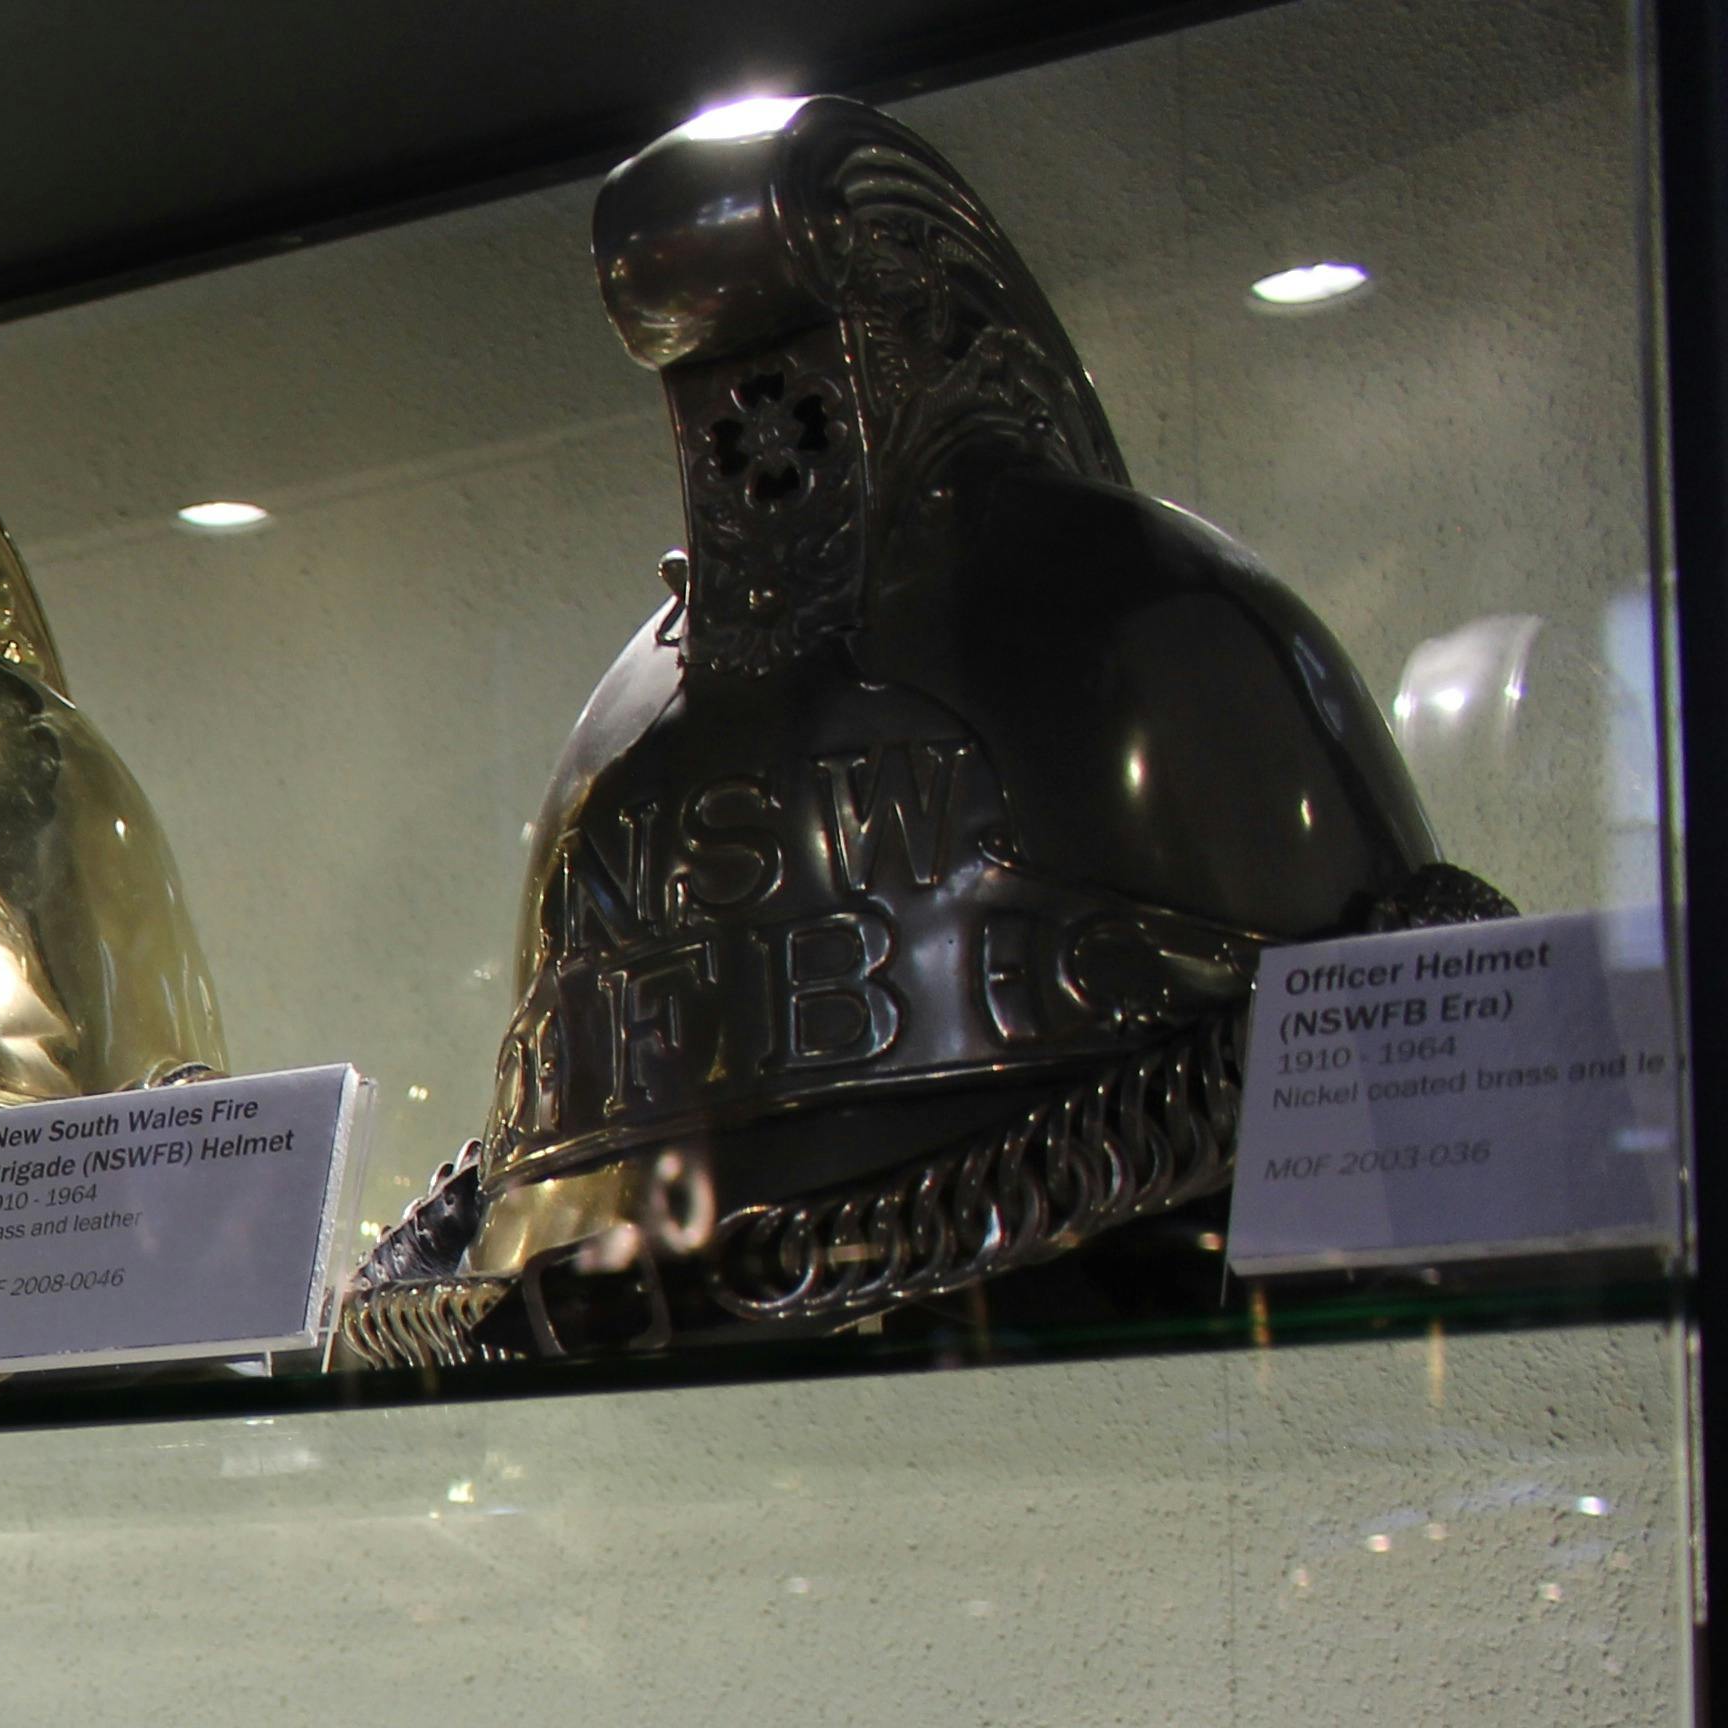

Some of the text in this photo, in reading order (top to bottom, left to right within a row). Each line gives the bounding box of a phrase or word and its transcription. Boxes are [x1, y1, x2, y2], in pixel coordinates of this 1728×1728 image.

[1285, 942, 1551, 996] Officer Helmet
[1279, 989, 1514, 1046] (NSWFB Era)
[1276, 1047, 1352, 1075] 1910
[1380, 1035, 1457, 1065] 1964
[1272, 1082, 1358, 1111] Nickel
[1367, 1069, 1466, 1101] coated
[1476, 1061, 1558, 1091] brass
[1568, 1053, 1627, 1082] and
[48, 1111, 119, 1143] South
[128, 1103, 203, 1133] Wales
[211, 1098, 258, 1122] Fire
[82, 1138, 193, 1178] (NSWFB)
[200, 1128, 294, 1161] Helmet
[1264, 1156, 1332, 1181] MOF
[46, 1184, 97, 1207] 1964
[31, 1215, 68, 1237] and
[73, 1210, 143, 1232] leather
[10, 1268, 124, 1297] 2008-0046
